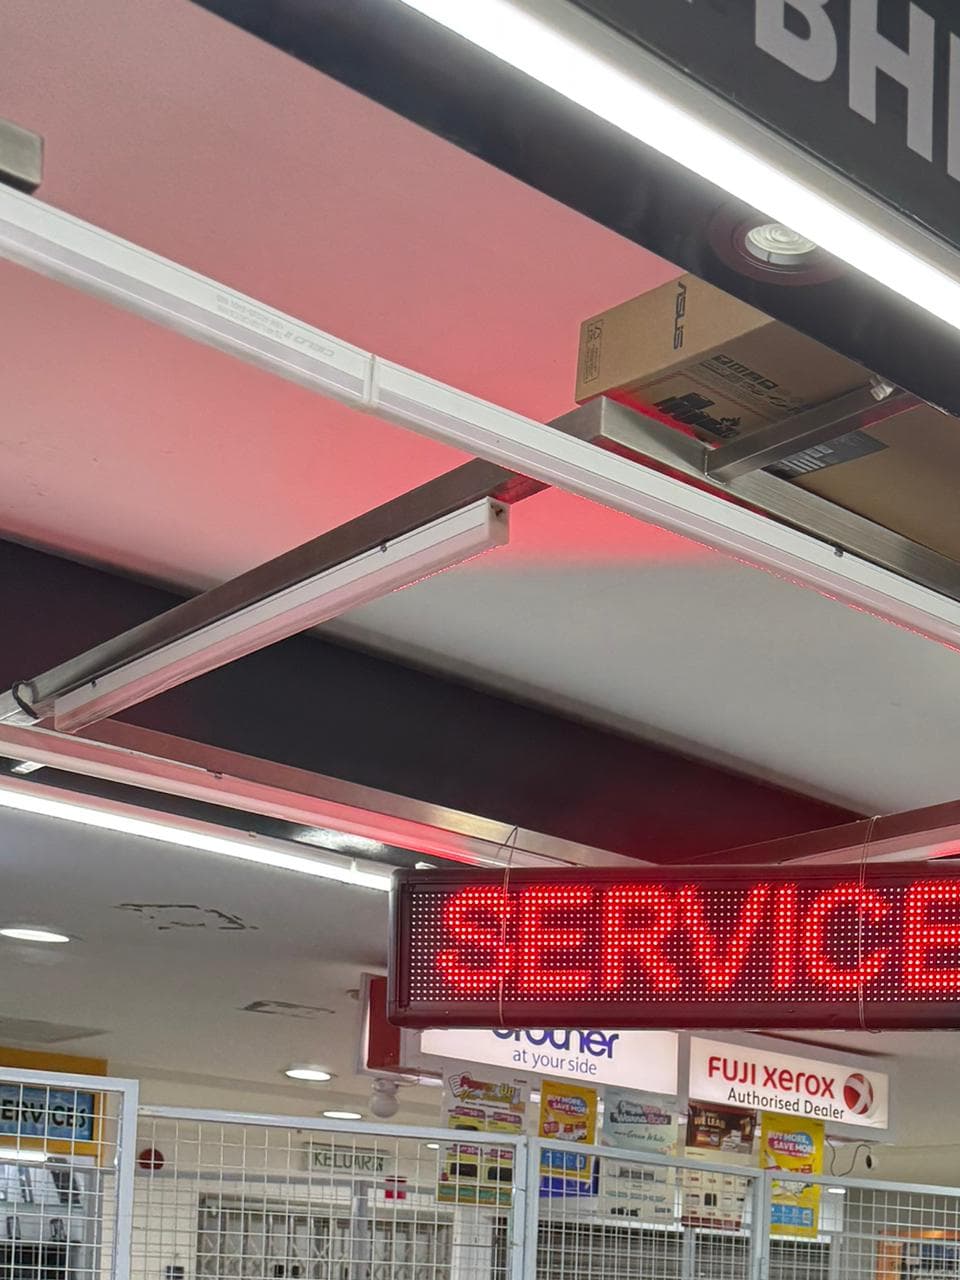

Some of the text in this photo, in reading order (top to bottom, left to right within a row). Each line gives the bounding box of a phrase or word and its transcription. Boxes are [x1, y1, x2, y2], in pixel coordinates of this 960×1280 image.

[673, 281, 687, 350] ASUS
[492, 1030, 619, 1059] other
[513, 1050, 597, 1075] at your side
[708, 1055, 757, 1086] FUJI
[728, 1087, 845, 1121] Authorised Dealer
